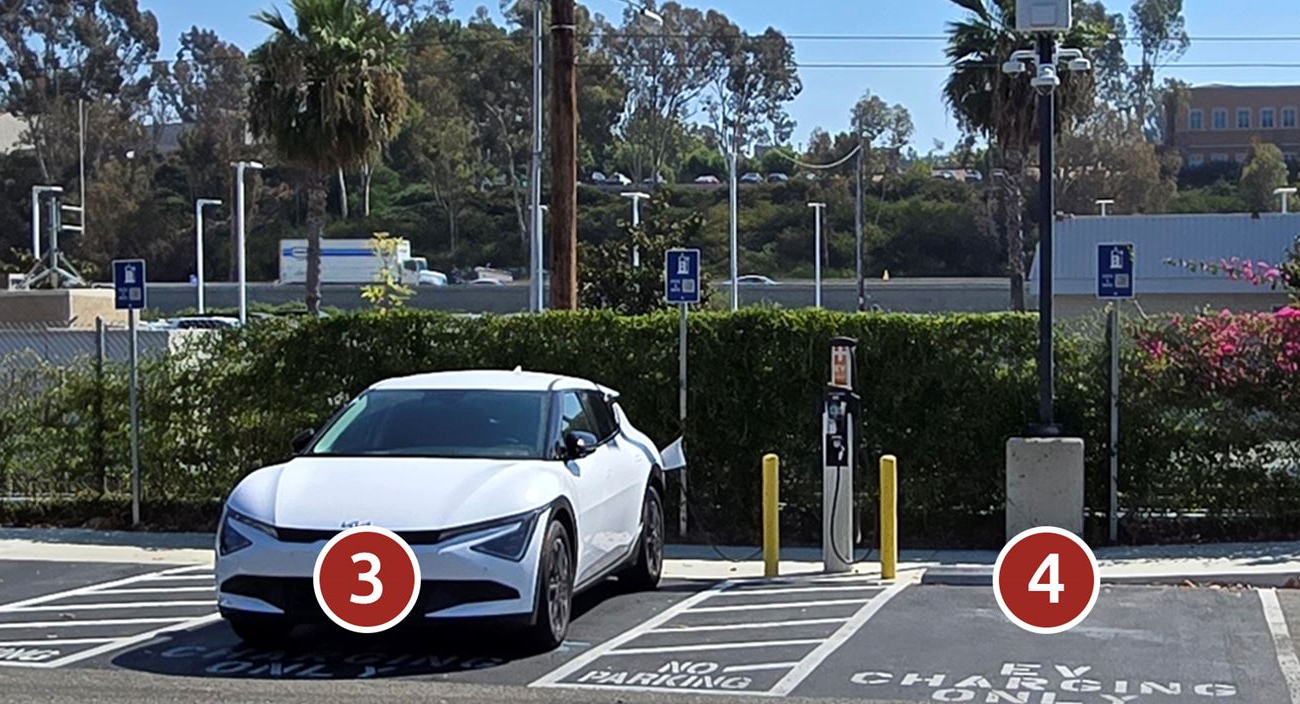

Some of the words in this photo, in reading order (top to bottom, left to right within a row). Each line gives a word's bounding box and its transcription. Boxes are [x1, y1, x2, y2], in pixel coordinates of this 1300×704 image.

[205, 660, 396, 678] ONLY
[658, 660, 719, 674] NO
[1001, 663, 1092, 678] EV
[577, 670, 753, 689] PARKING
[850, 671, 1237, 697] CHARGING
[931, 688, 1140, 704] ONLY
